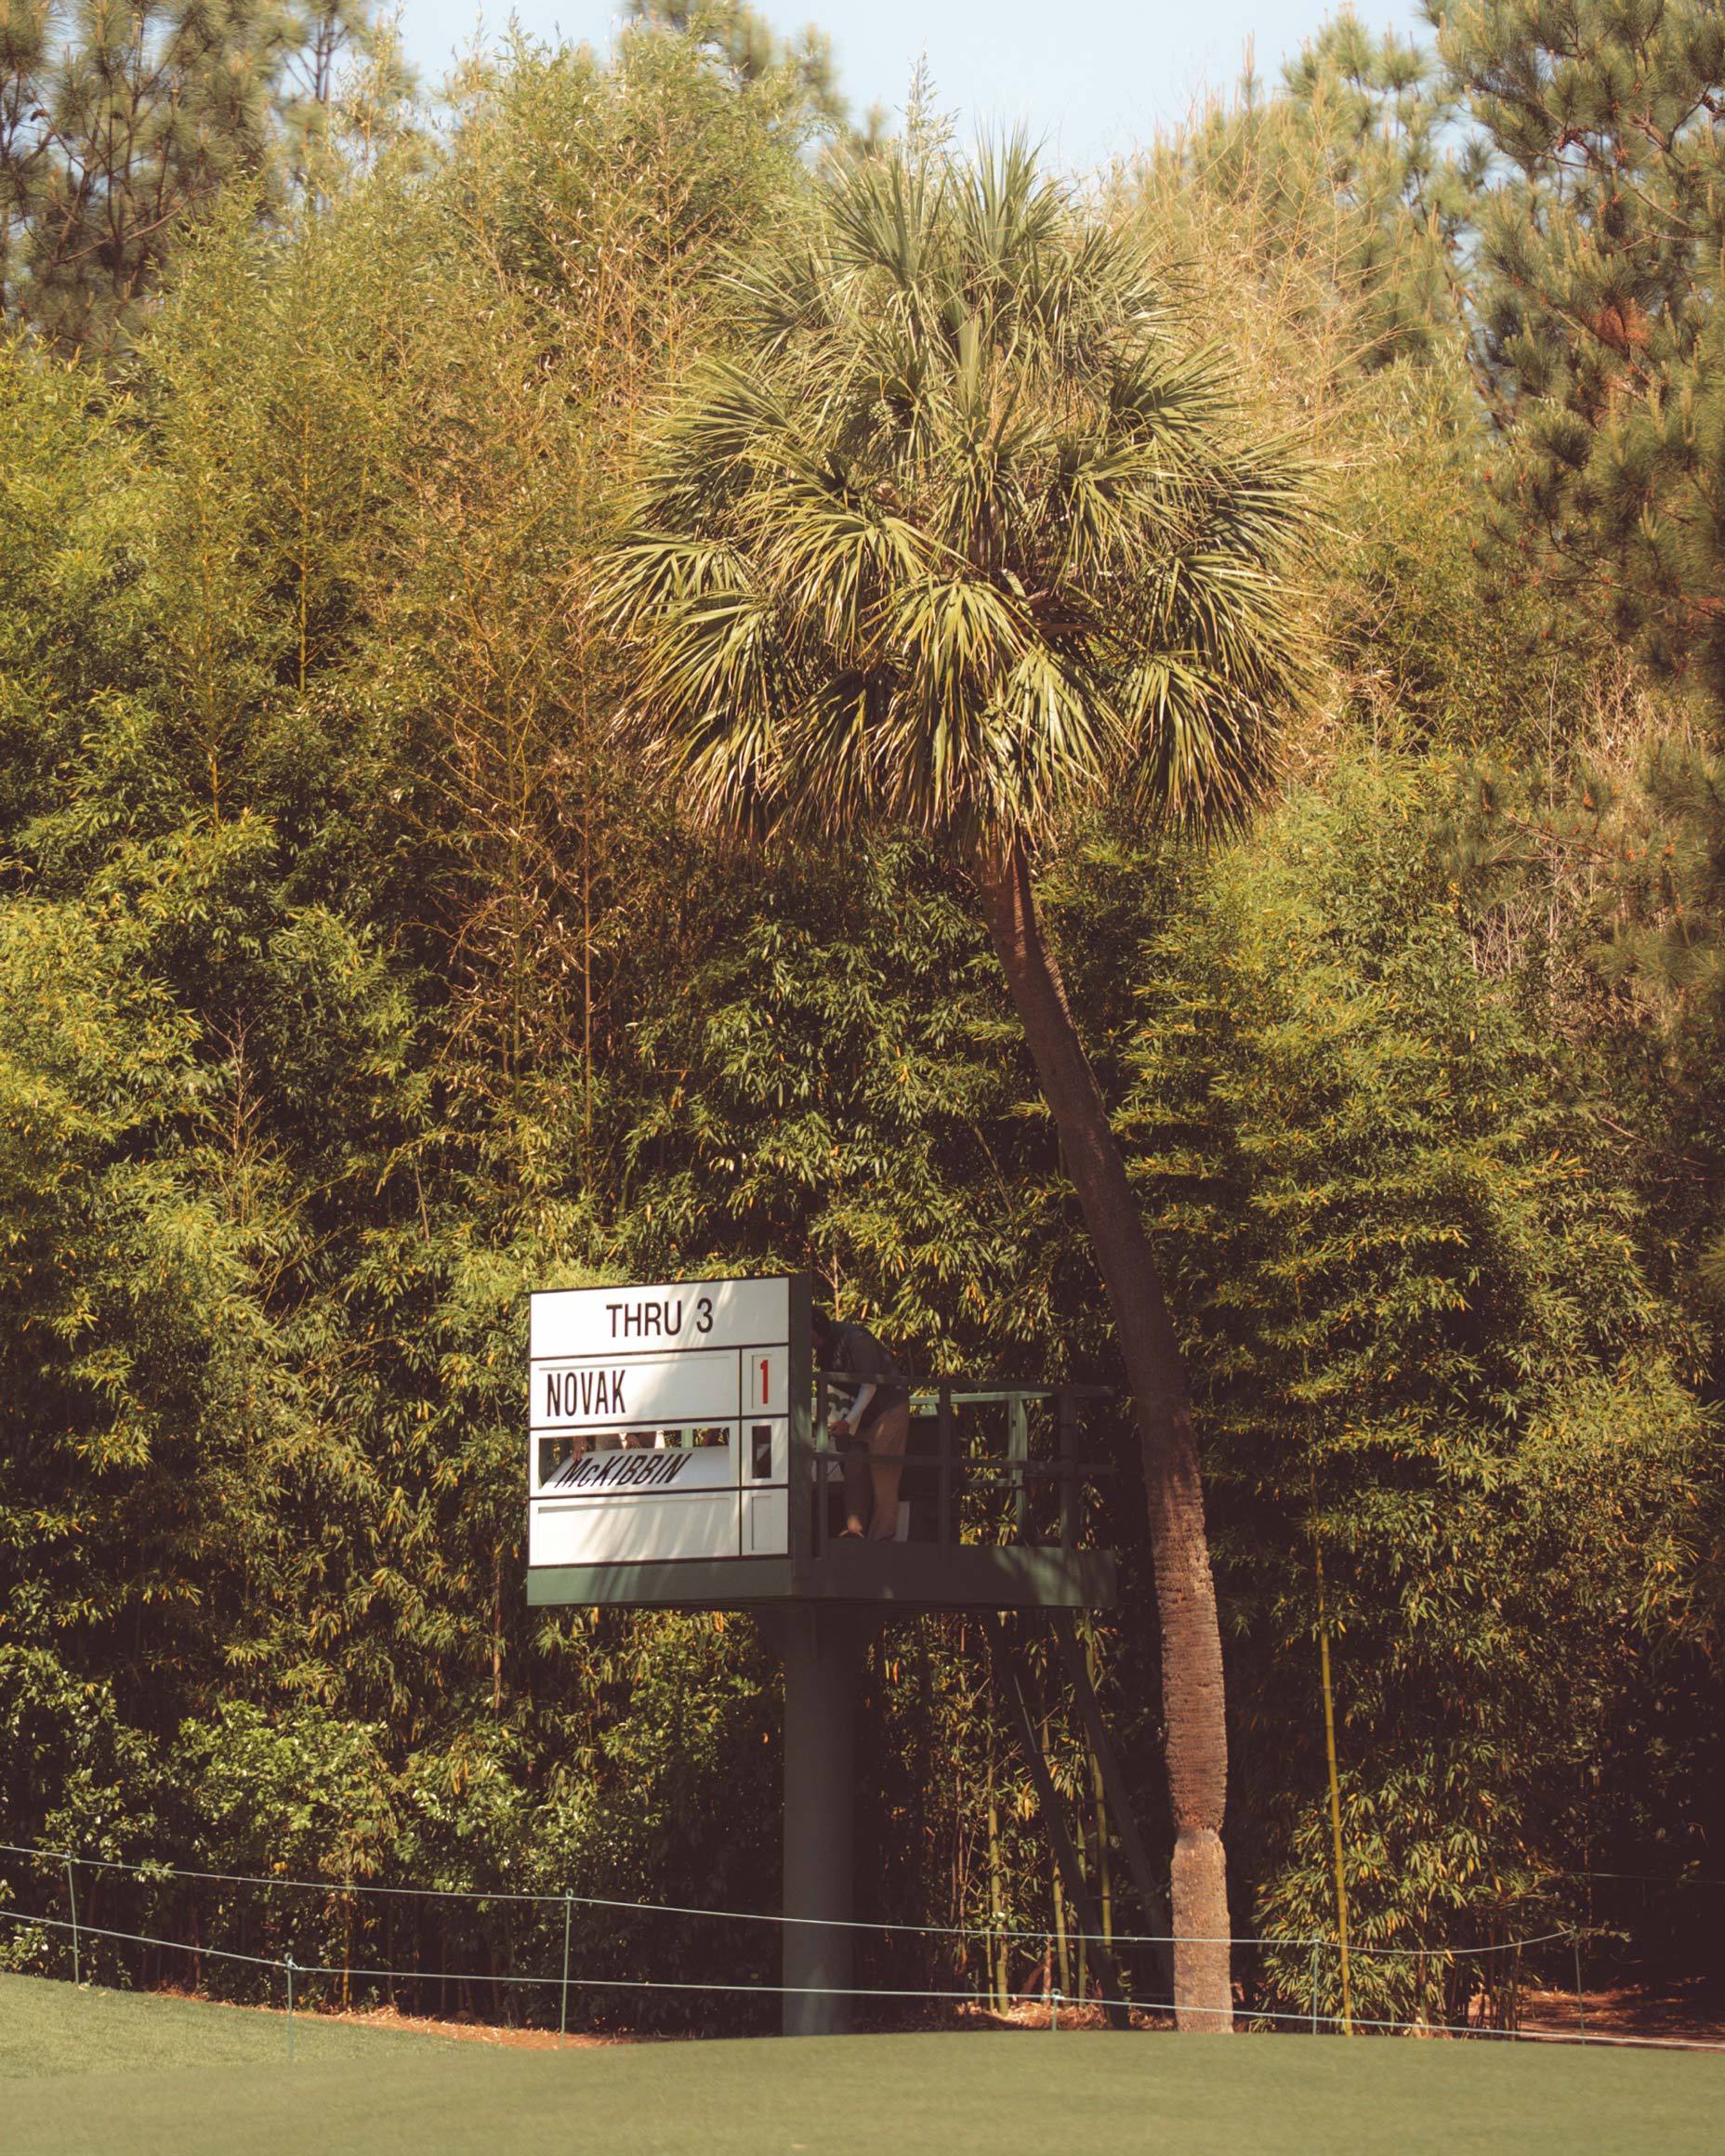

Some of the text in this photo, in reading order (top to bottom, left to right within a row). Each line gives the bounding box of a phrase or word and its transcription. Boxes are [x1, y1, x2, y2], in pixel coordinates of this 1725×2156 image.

[606, 1297, 714, 1338] THRU 3
[546, 1369, 626, 1417] NOVAK
[759, 1359, 770, 1405] 1
[554, 1452, 693, 1489] McKIBBIN
